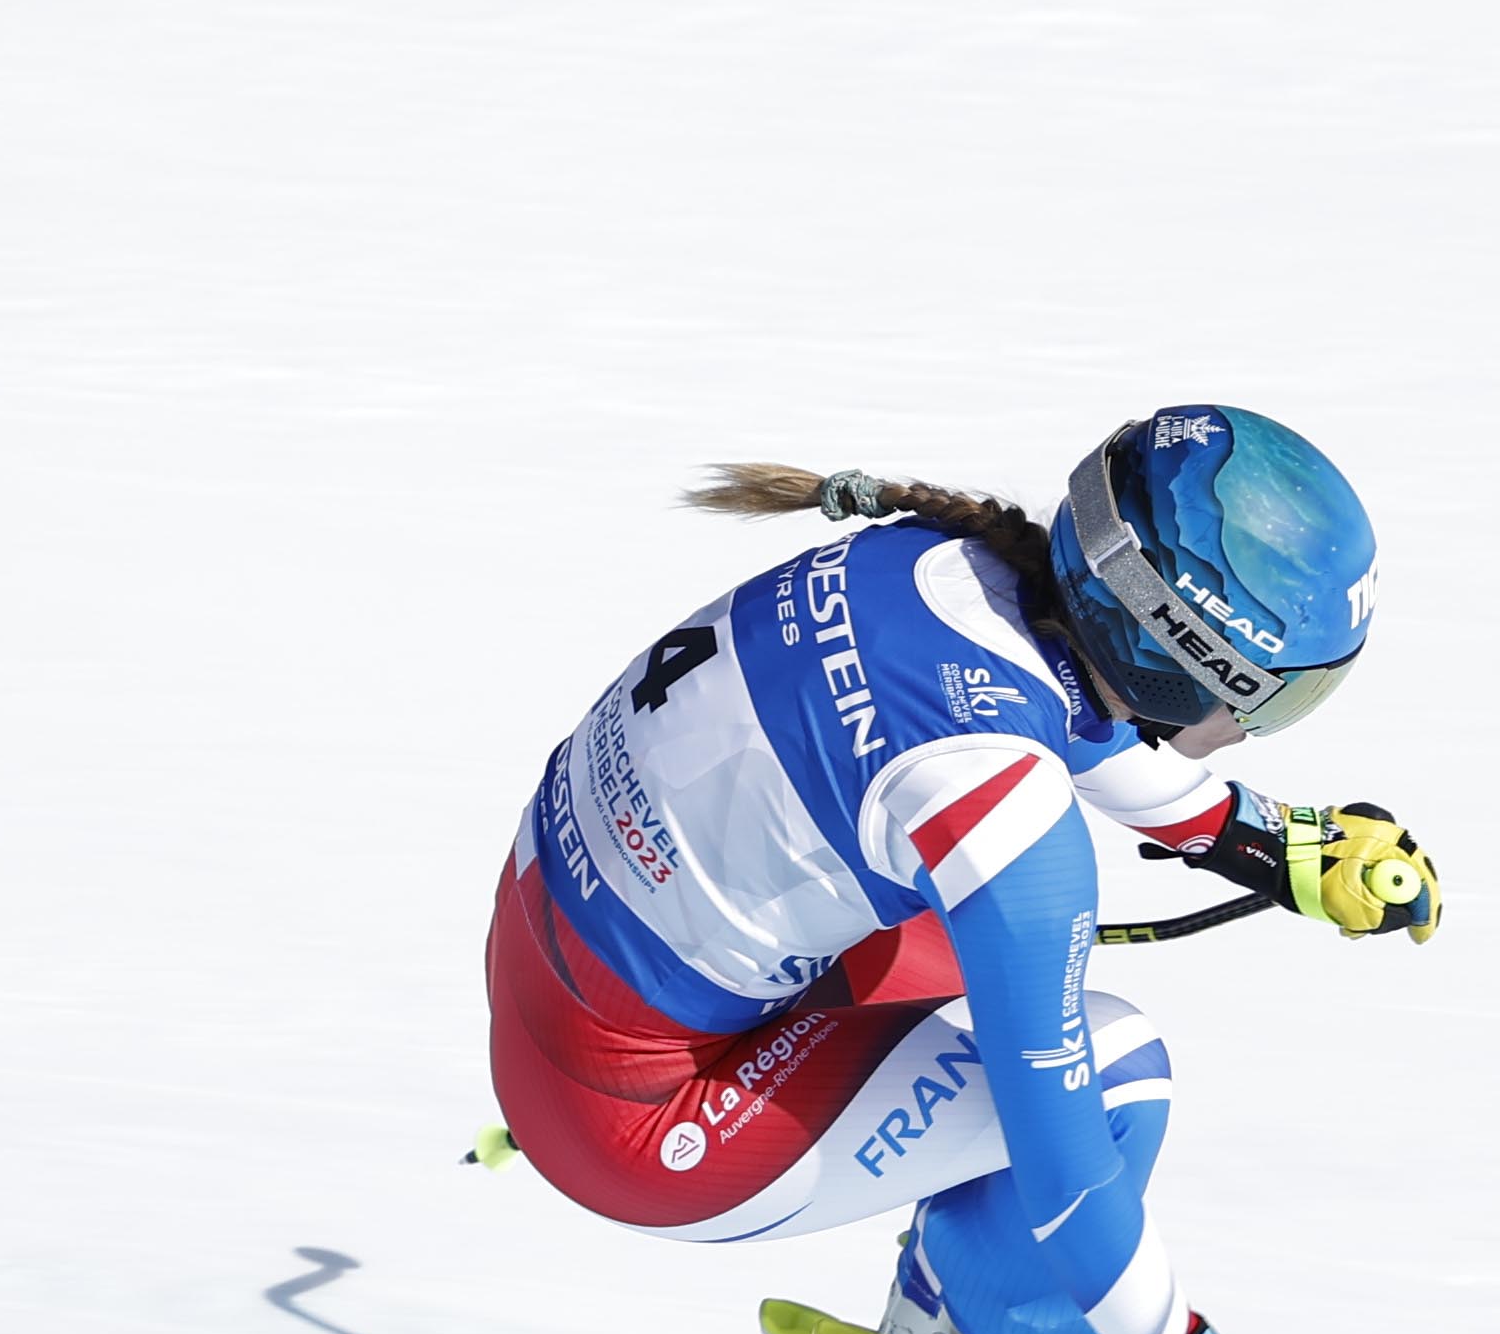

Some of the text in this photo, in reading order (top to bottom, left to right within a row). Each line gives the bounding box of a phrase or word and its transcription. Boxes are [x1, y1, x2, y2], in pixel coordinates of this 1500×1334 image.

[776, 560, 801, 646] TYRES
[806, 535, 887, 759] DESTEIN
[1151, 603, 1260, 696] HEAD
[1175, 572, 1284, 654] HEAD
[631, 626, 718, 715] 4
[609, 685, 680, 869] COURCHEVEL
[594, 796, 603, 814] SKI
[602, 814, 657, 894] CHAMPIONSHIPS
[616, 811, 673, 884] 2023
[1062, 912, 1082, 1017] COURCHEVEL
[702, 1012, 826, 1126] La Région
[720, 1021, 838, 1144] Auvergne-Rhône-Alpes
[854, 1033, 983, 1178] FRAN
